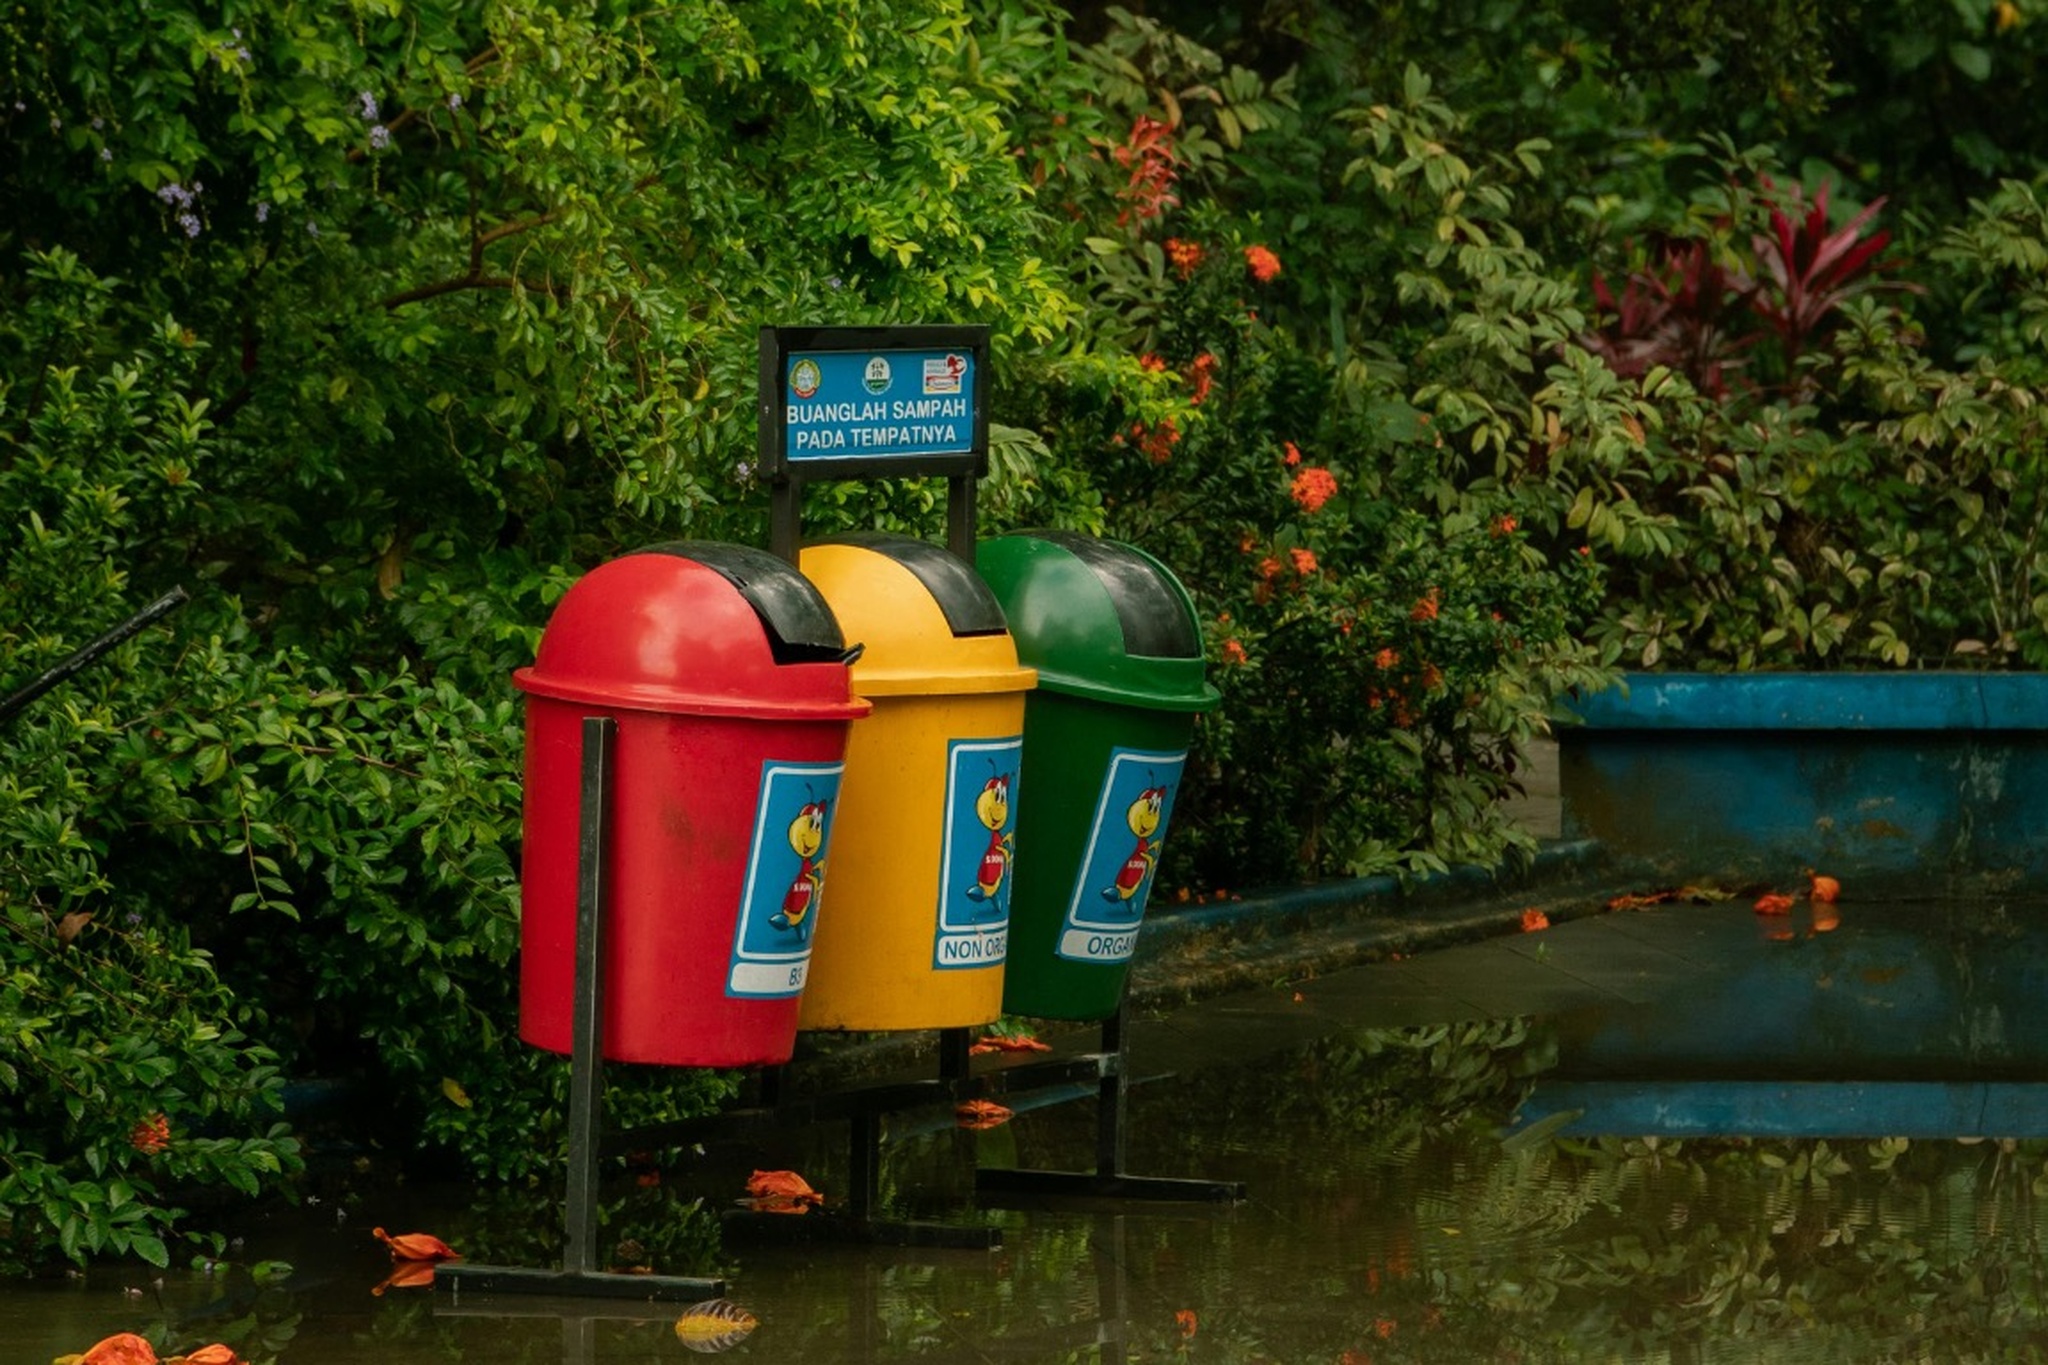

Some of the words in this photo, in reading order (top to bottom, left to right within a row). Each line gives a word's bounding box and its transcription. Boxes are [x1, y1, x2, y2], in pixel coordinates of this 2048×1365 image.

[787, 402, 887, 424] BUANGLAH
[892, 398, 966, 420] SAMPAH
[797, 429, 846, 450] PADA
[851, 424, 956, 447] TEMPATNYA
[945, 940, 982, 959] NON
[1087, 936, 1135, 955] ORGA
